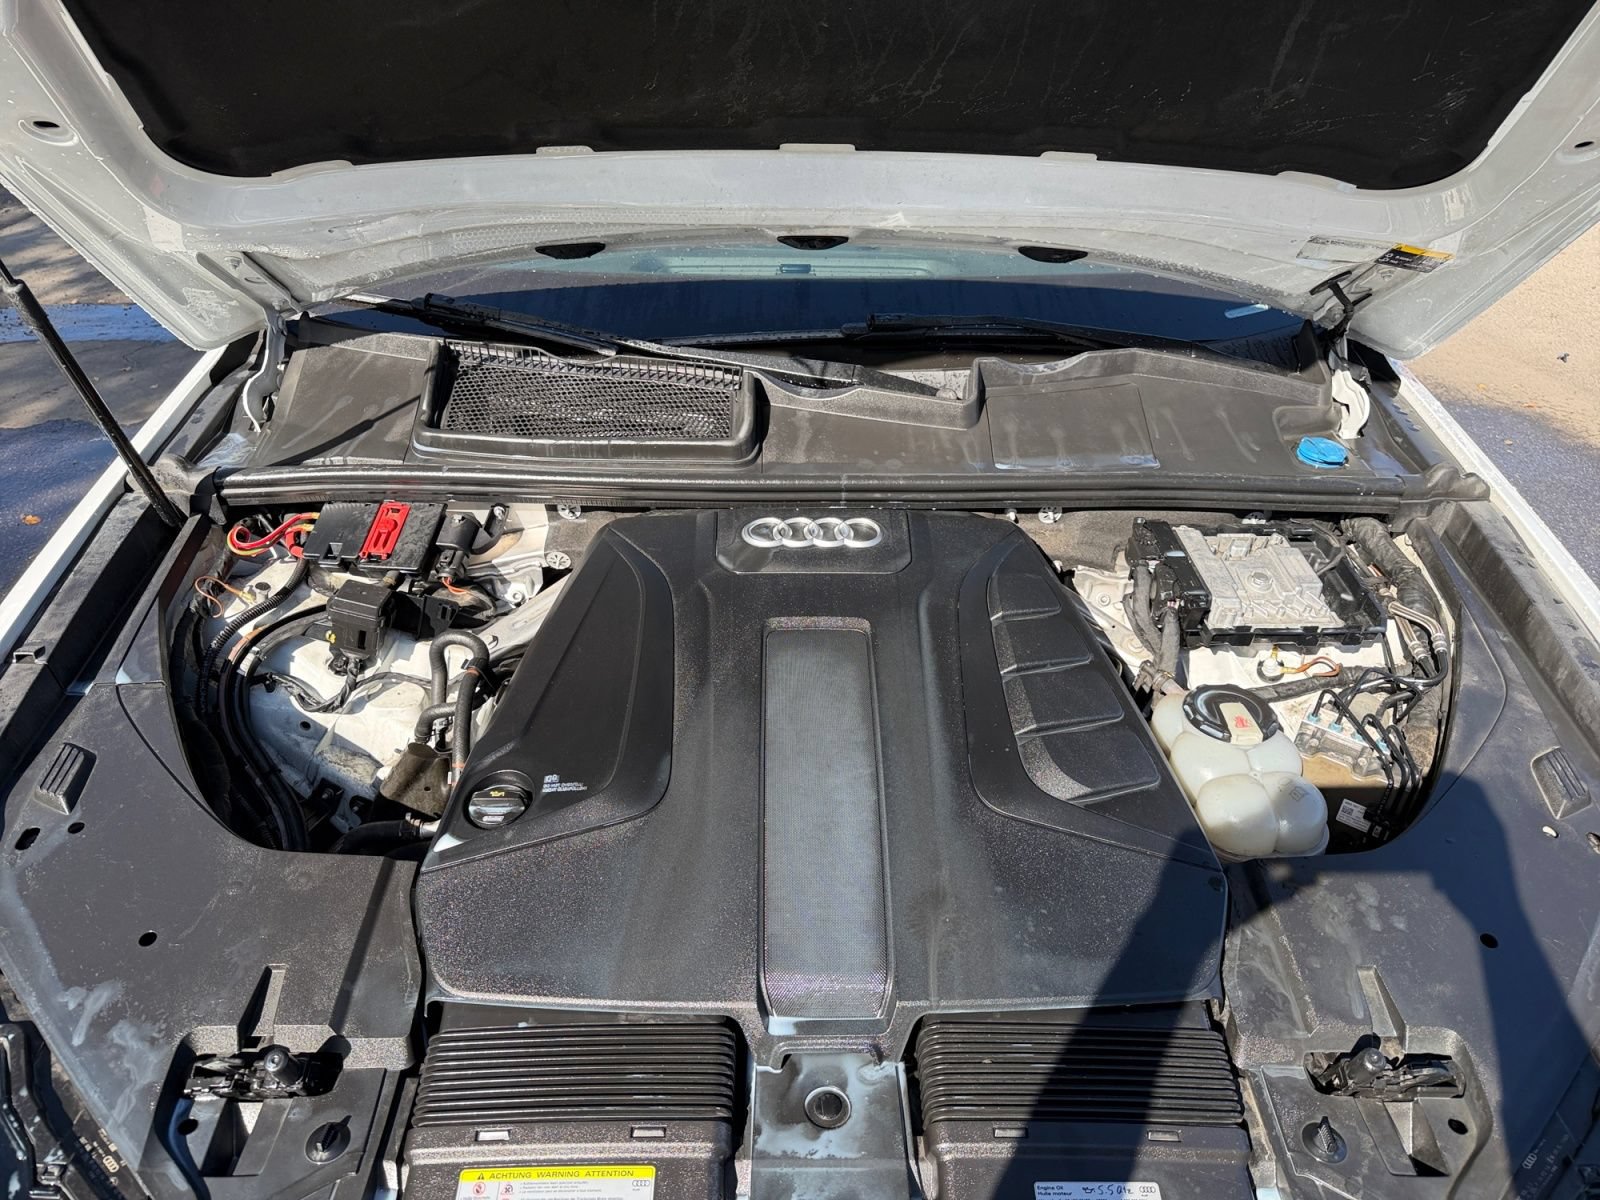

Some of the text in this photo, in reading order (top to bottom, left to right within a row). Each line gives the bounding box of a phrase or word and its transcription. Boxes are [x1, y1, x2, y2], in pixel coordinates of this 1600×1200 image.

[489, 1170, 634, 1180] ACHTUNG WARNING ATTENTION
